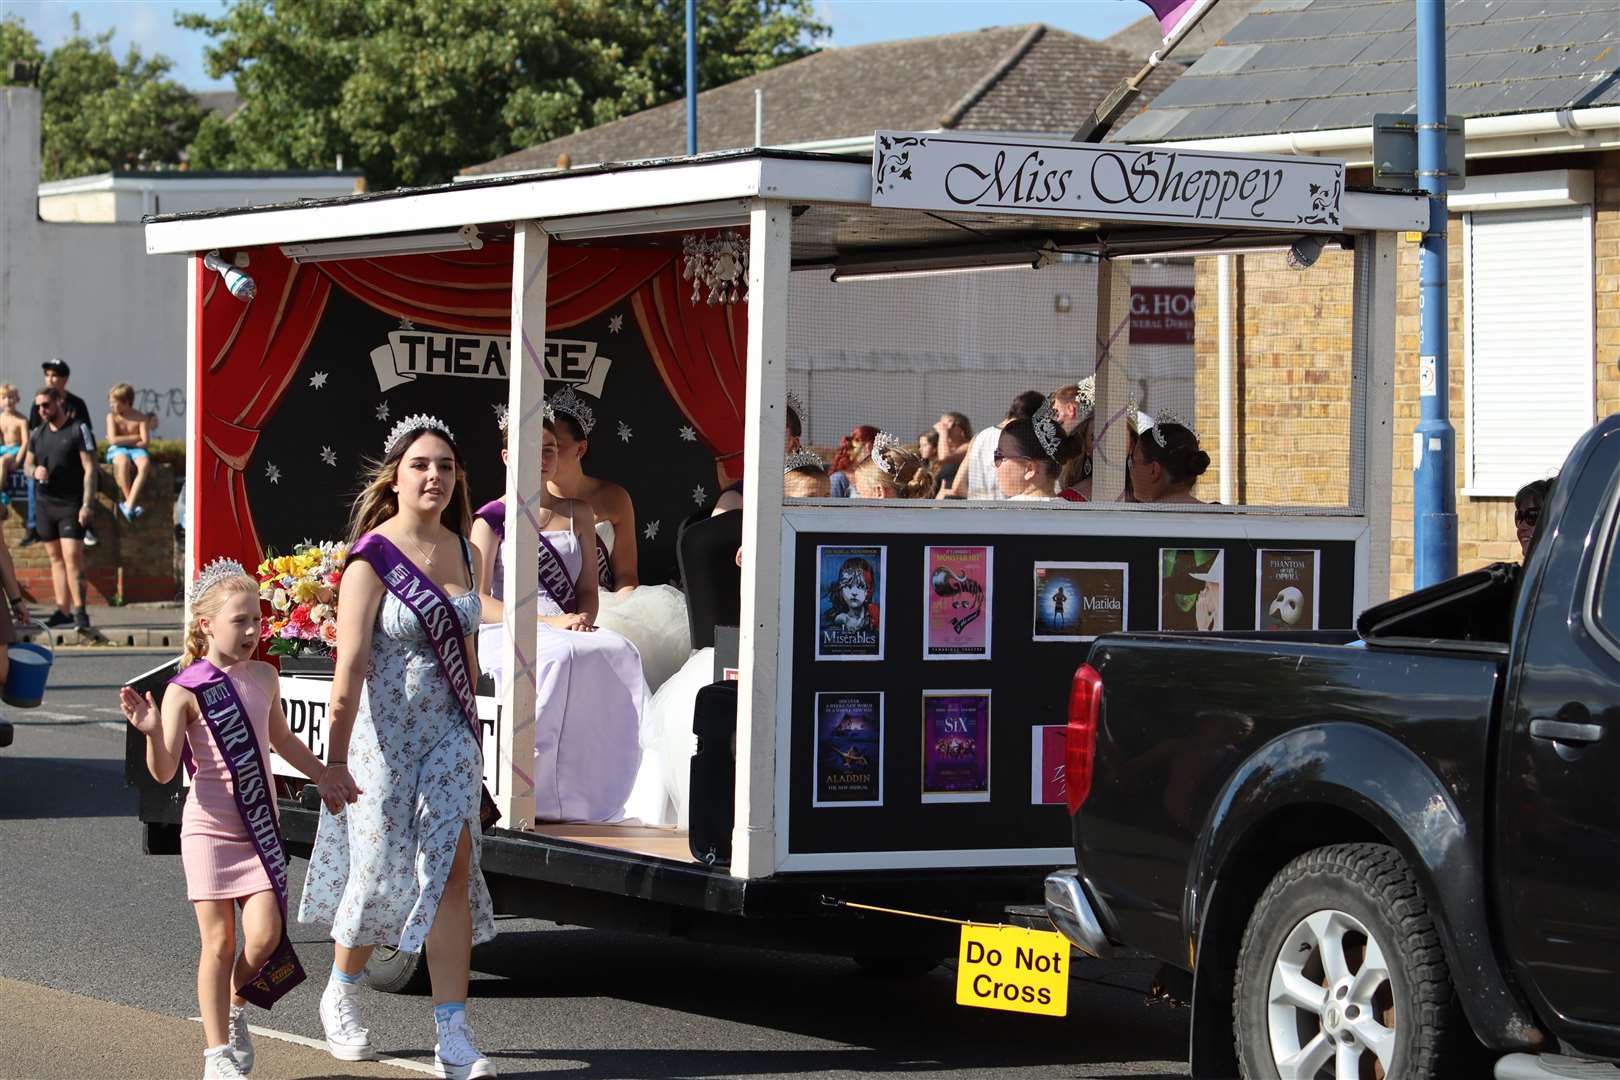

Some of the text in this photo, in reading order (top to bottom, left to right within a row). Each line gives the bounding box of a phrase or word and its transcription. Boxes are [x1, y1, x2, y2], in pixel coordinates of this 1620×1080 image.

[944, 151, 1283, 219] Miss Sheppey
[400, 335, 587, 378] THEARE
[1270, 560, 1305, 568] PHANTOM
[400, 576, 451, 640] MISS
[1083, 596, 1121, 610] Matilda
[207, 703, 250, 751] JNR
[231, 747, 266, 806] MISS
[826, 774, 871, 783] ALADDIN
[966, 941, 1061, 974] Do Not
[973, 974, 1051, 1004] Cross
